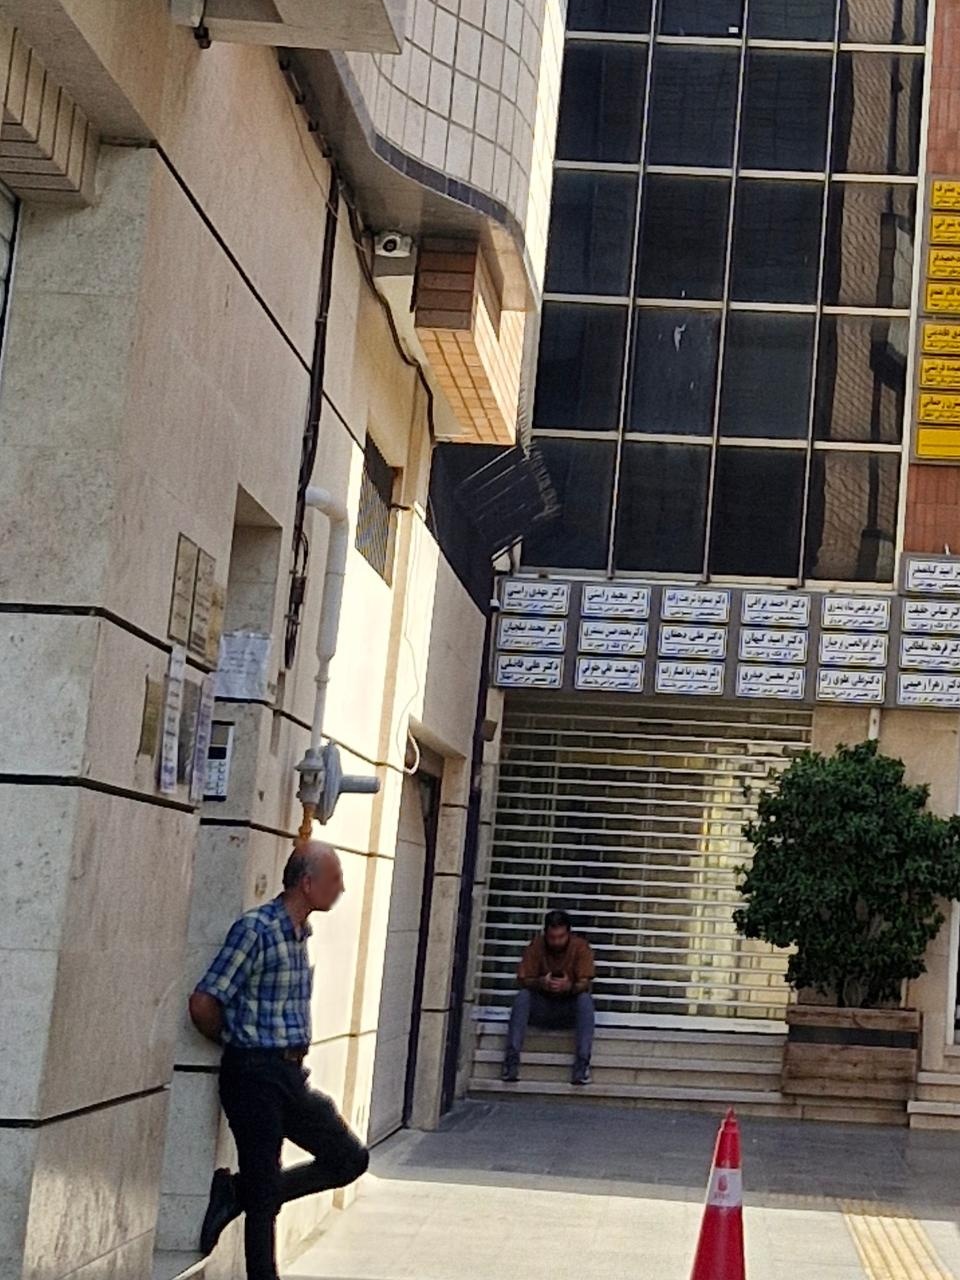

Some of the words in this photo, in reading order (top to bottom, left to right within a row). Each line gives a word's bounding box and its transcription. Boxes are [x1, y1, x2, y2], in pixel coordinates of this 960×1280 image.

[551, 587, 565, 599] دکتر
[630, 591, 645, 602] دکتر
[789, 599, 805, 610] دکتر
[548, 624, 562, 634] دکتر
[707, 632, 722, 642] دکتر
[786, 635, 803, 647] دکتر
[543, 661, 559, 672] دکتر
[786, 671, 801, 683] دکتر
